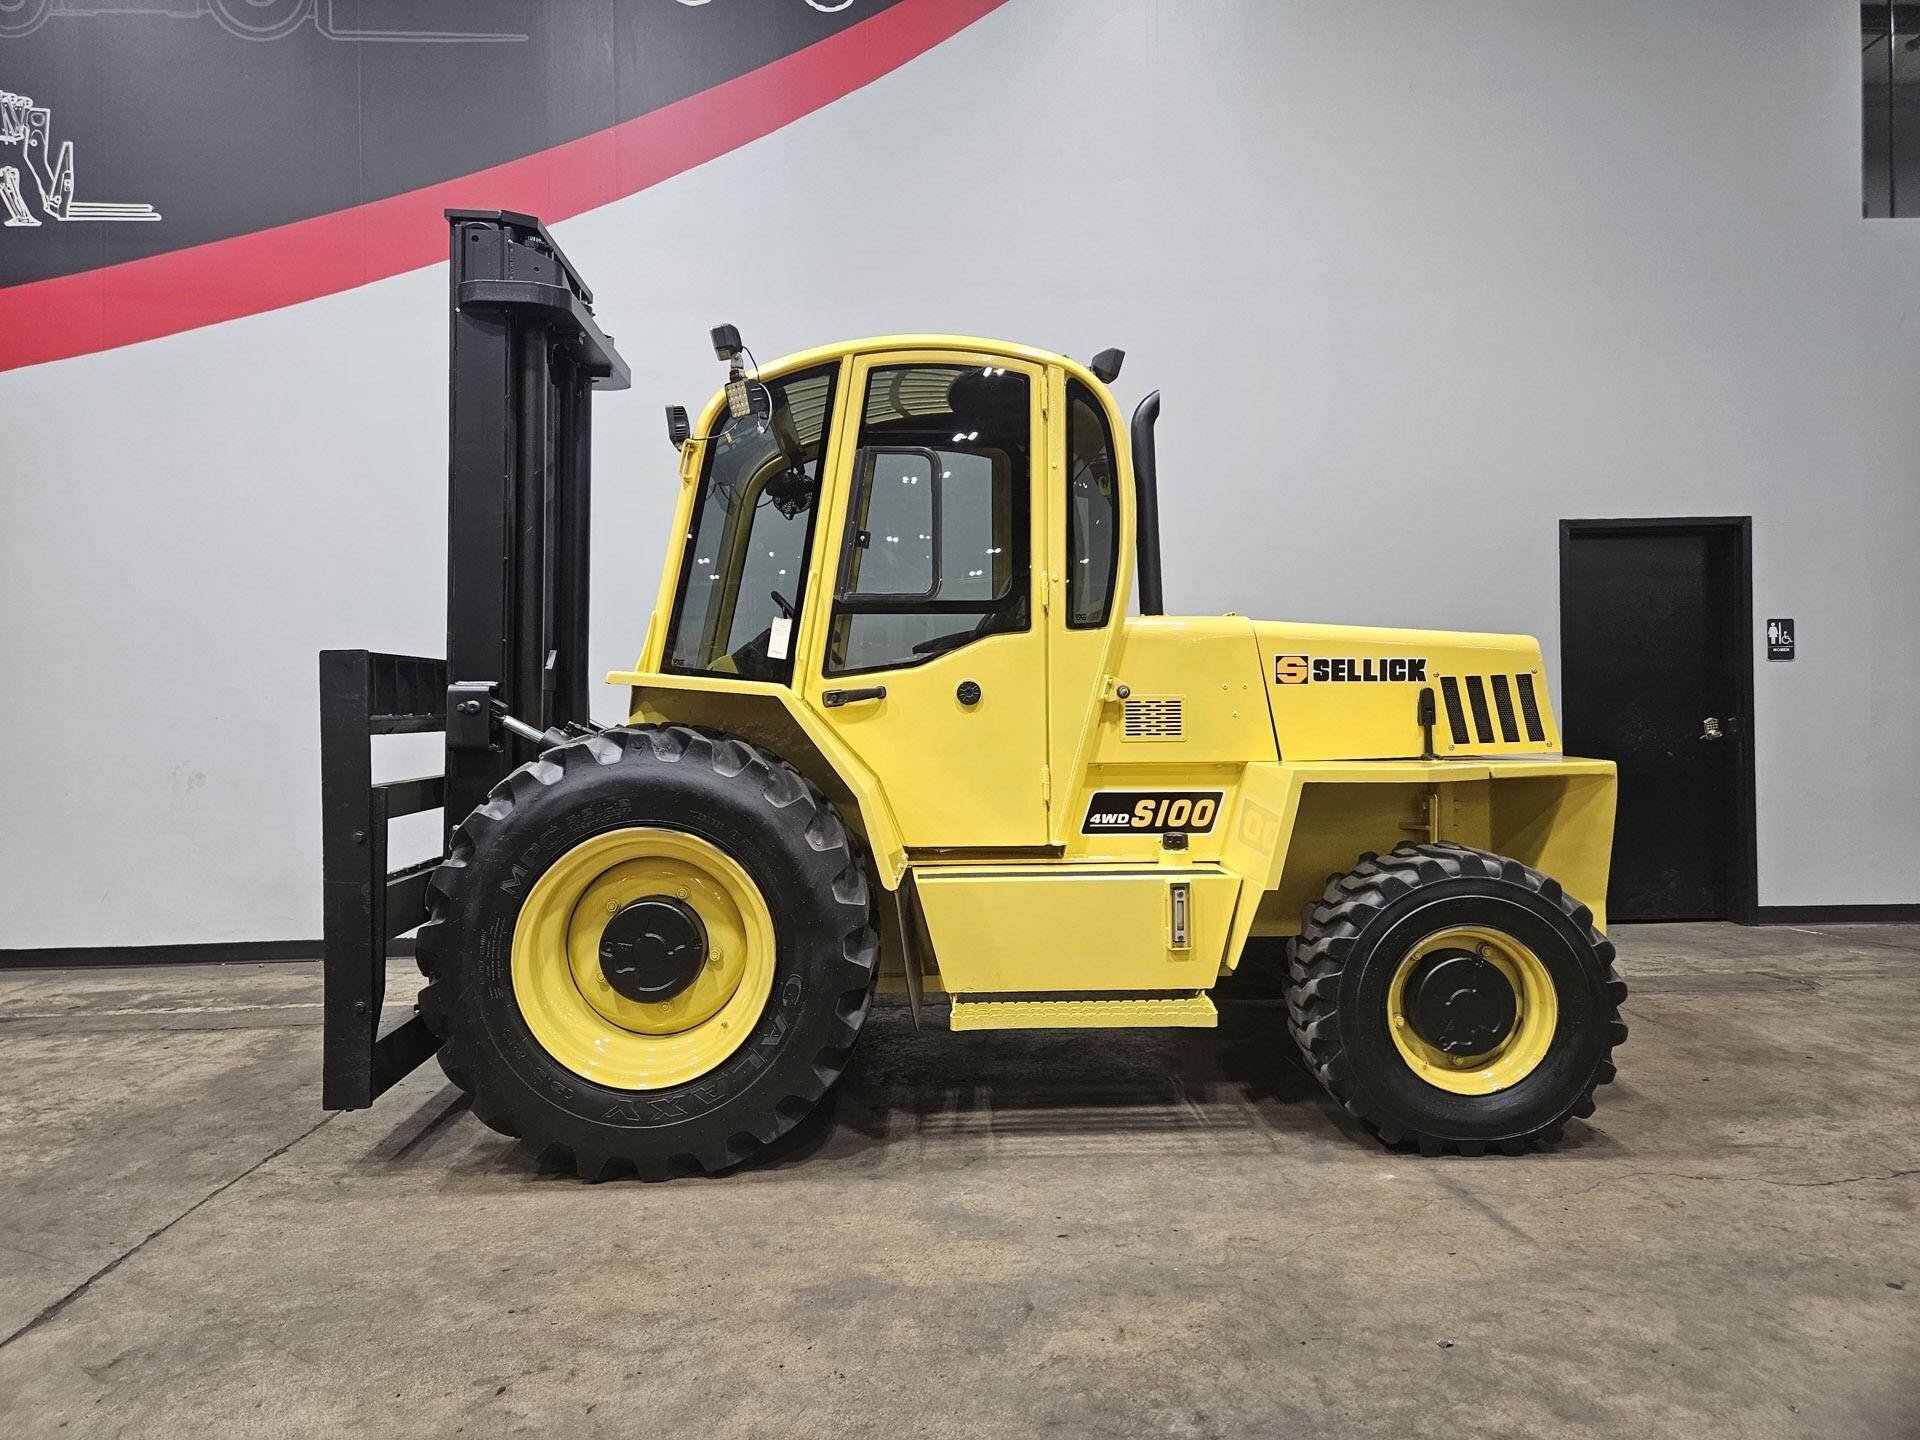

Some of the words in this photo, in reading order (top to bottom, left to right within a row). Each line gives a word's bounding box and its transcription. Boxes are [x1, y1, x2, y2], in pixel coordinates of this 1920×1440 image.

[1312, 658, 1427, 682] SELLICK
[1089, 813, 1129, 825] 4WD
[1130, 799, 1215, 828] S100
[601, 973, 803, 1122] GALAXY
